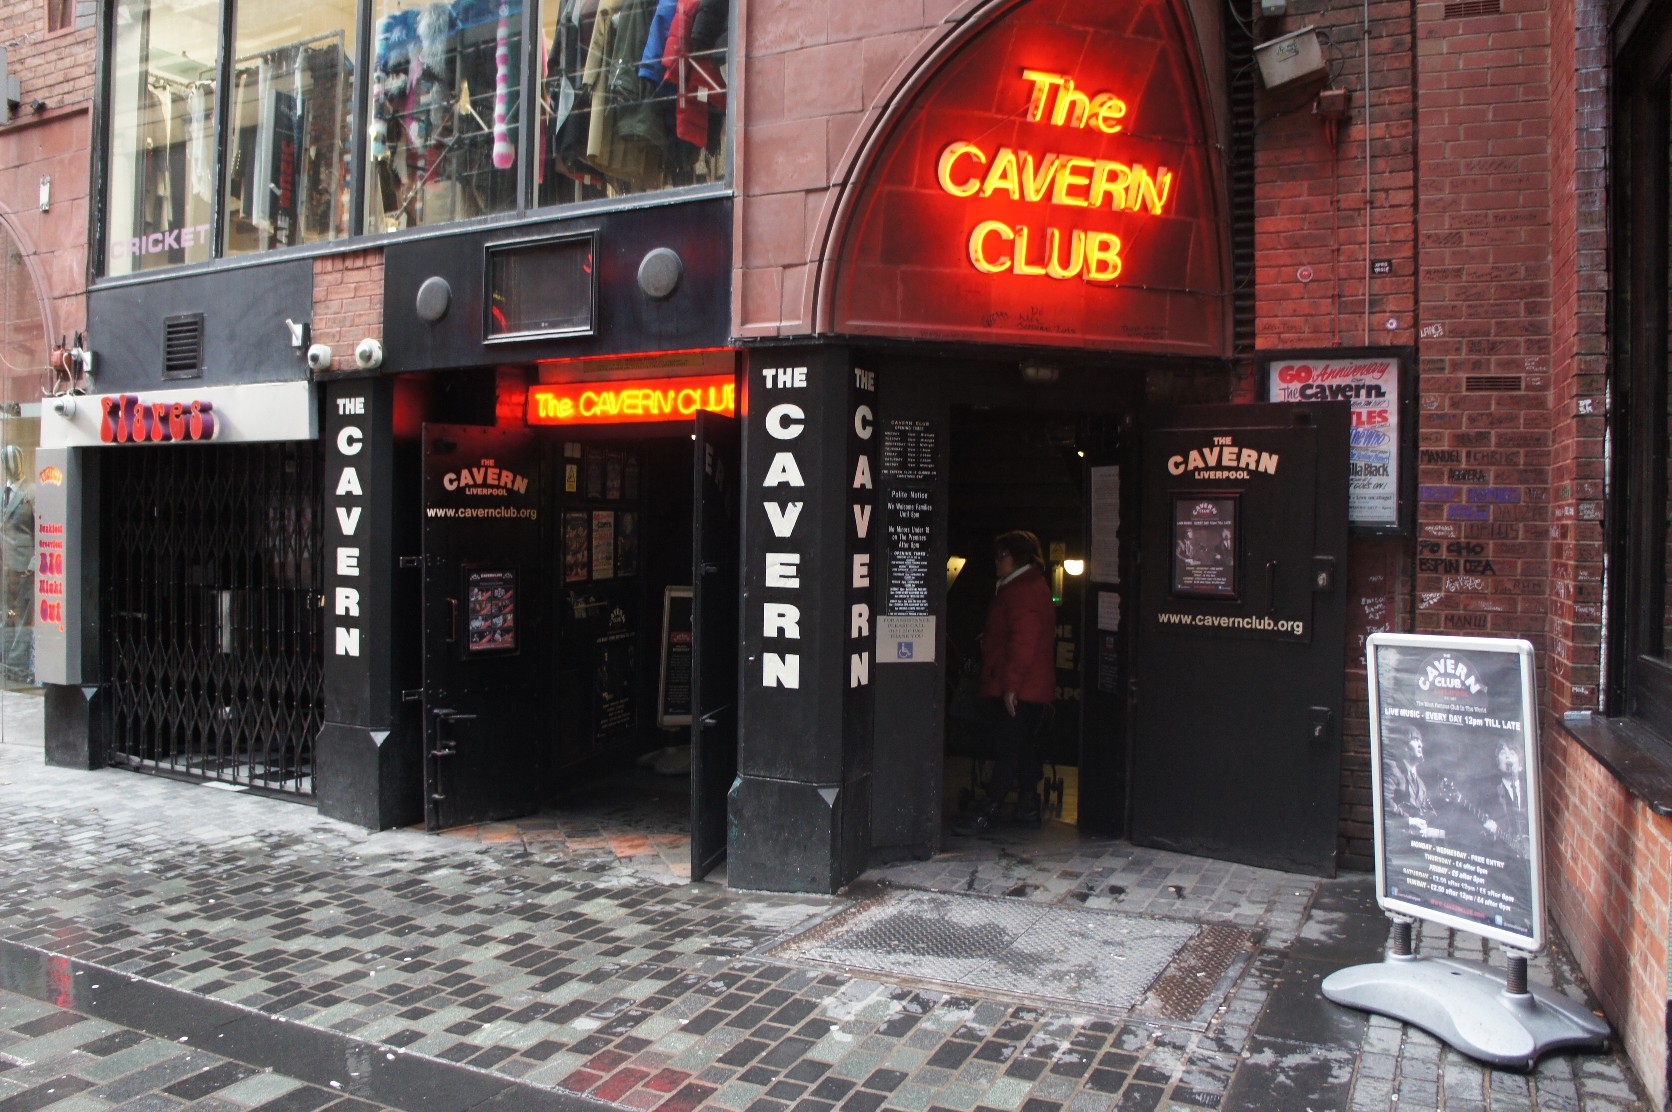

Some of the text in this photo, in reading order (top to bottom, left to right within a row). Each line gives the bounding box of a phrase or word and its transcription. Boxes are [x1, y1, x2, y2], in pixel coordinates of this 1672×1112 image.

[1022, 70, 1127, 133] The
[938, 141, 1171, 215] CAVERN
[110, 224, 209, 260] CRICKET
[969, 220, 1122, 281] CLUB
[763, 367, 808, 388] THE
[855, 368, 875, 391] THE
[1312, 364, 1390, 383] Anniversary
[334, 397, 364, 414] THE
[536, 393, 573, 417] The
[580, 389, 674, 416] CAVERN
[1350, 409, 1389, 426] TLES
[1213, 437, 1232, 446] THE
[1168, 446, 1279, 475] CAVERN
[1350, 463, 1390, 477] illa Black
[443, 467, 529, 494] CAVERN
[1195, 471, 1250, 480] LIVERPOOL
[466, 488, 508, 496] LIVERPOOL
[891, 490, 928, 499] Polite Notice
[426, 506, 537, 520] www.cavernclub.org
[335, 426, 363, 656] CAVERN
[763, 404, 806, 689] CAVERN
[851, 405, 874, 688] CAVERN
[1158, 613, 1304, 635] www.cavernclub.org
[1418, 658, 1481, 695] CAVERN
[1434, 677, 1462, 689] CLUB
[1384, 707, 1521, 731] LIVE MUSIC EVERY DAY 12pm TILL LATE
[1410, 840, 1505, 869] MONDAY WEDNESDAY FREE ENTRY
[1424, 853, 1452, 866] THURSDAY
[1463, 862, 1476, 872] after
[1402, 867, 1429, 880] SATURDAY
[1447, 879, 1460, 888] after
[1487, 889, 1501, 899] after
[1428, 864, 1449, 875] FRIDAY
[1459, 871, 1473, 881] after
[1406, 877, 1427, 889] SUNDAY
[1445, 887, 1458, 897] after
